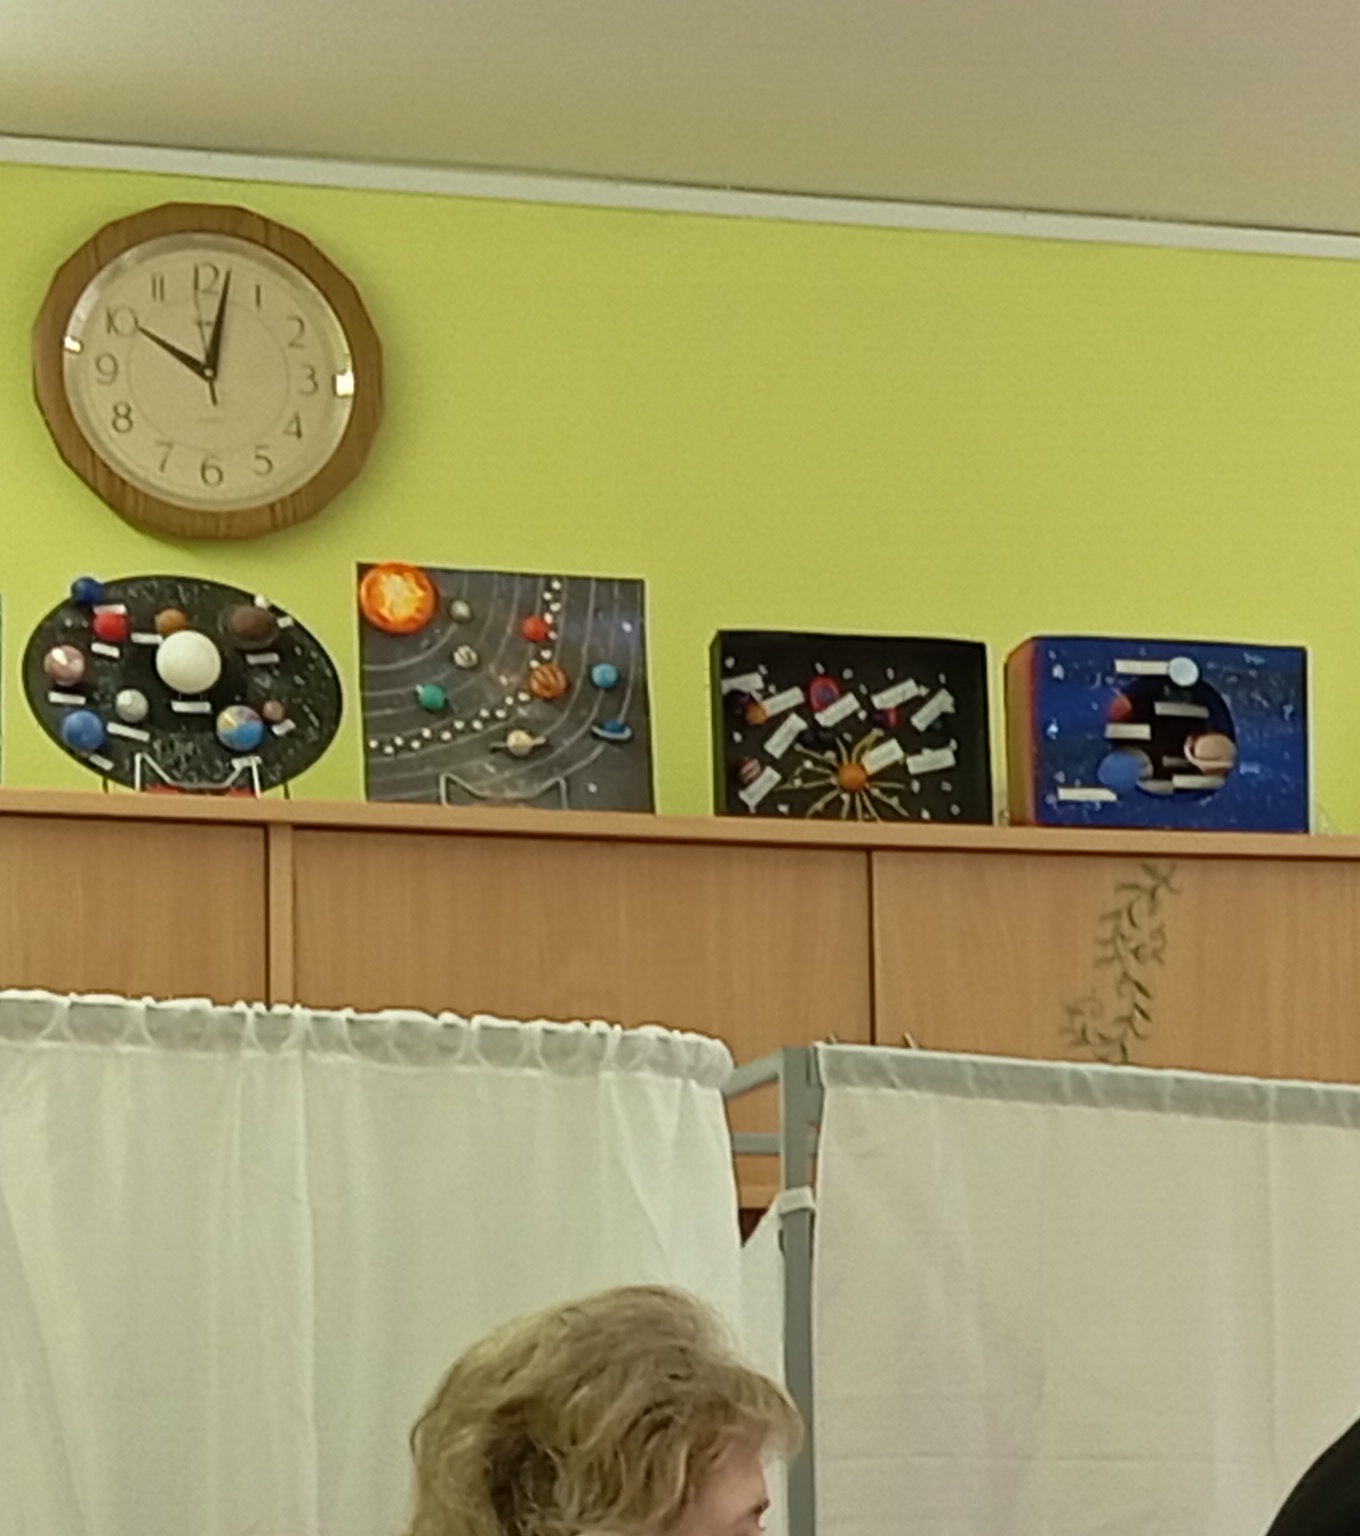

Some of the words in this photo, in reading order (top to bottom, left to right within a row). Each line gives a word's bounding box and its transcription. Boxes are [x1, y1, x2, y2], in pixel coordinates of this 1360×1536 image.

[151, 273, 165, 303] 11
[193, 262, 219, 295] 12
[254, 283, 262, 310] 1
[106, 305, 139, 336] 10
[287, 315, 306, 350] 2
[95, 352, 118, 386] 9
[301, 364, 319, 396] 3
[111, 402, 134, 434] 8
[283, 411, 303, 440] 4
[155, 441, 174, 473] 7
[200, 454, 224, 488] 6
[254, 444, 274, 476] 5
